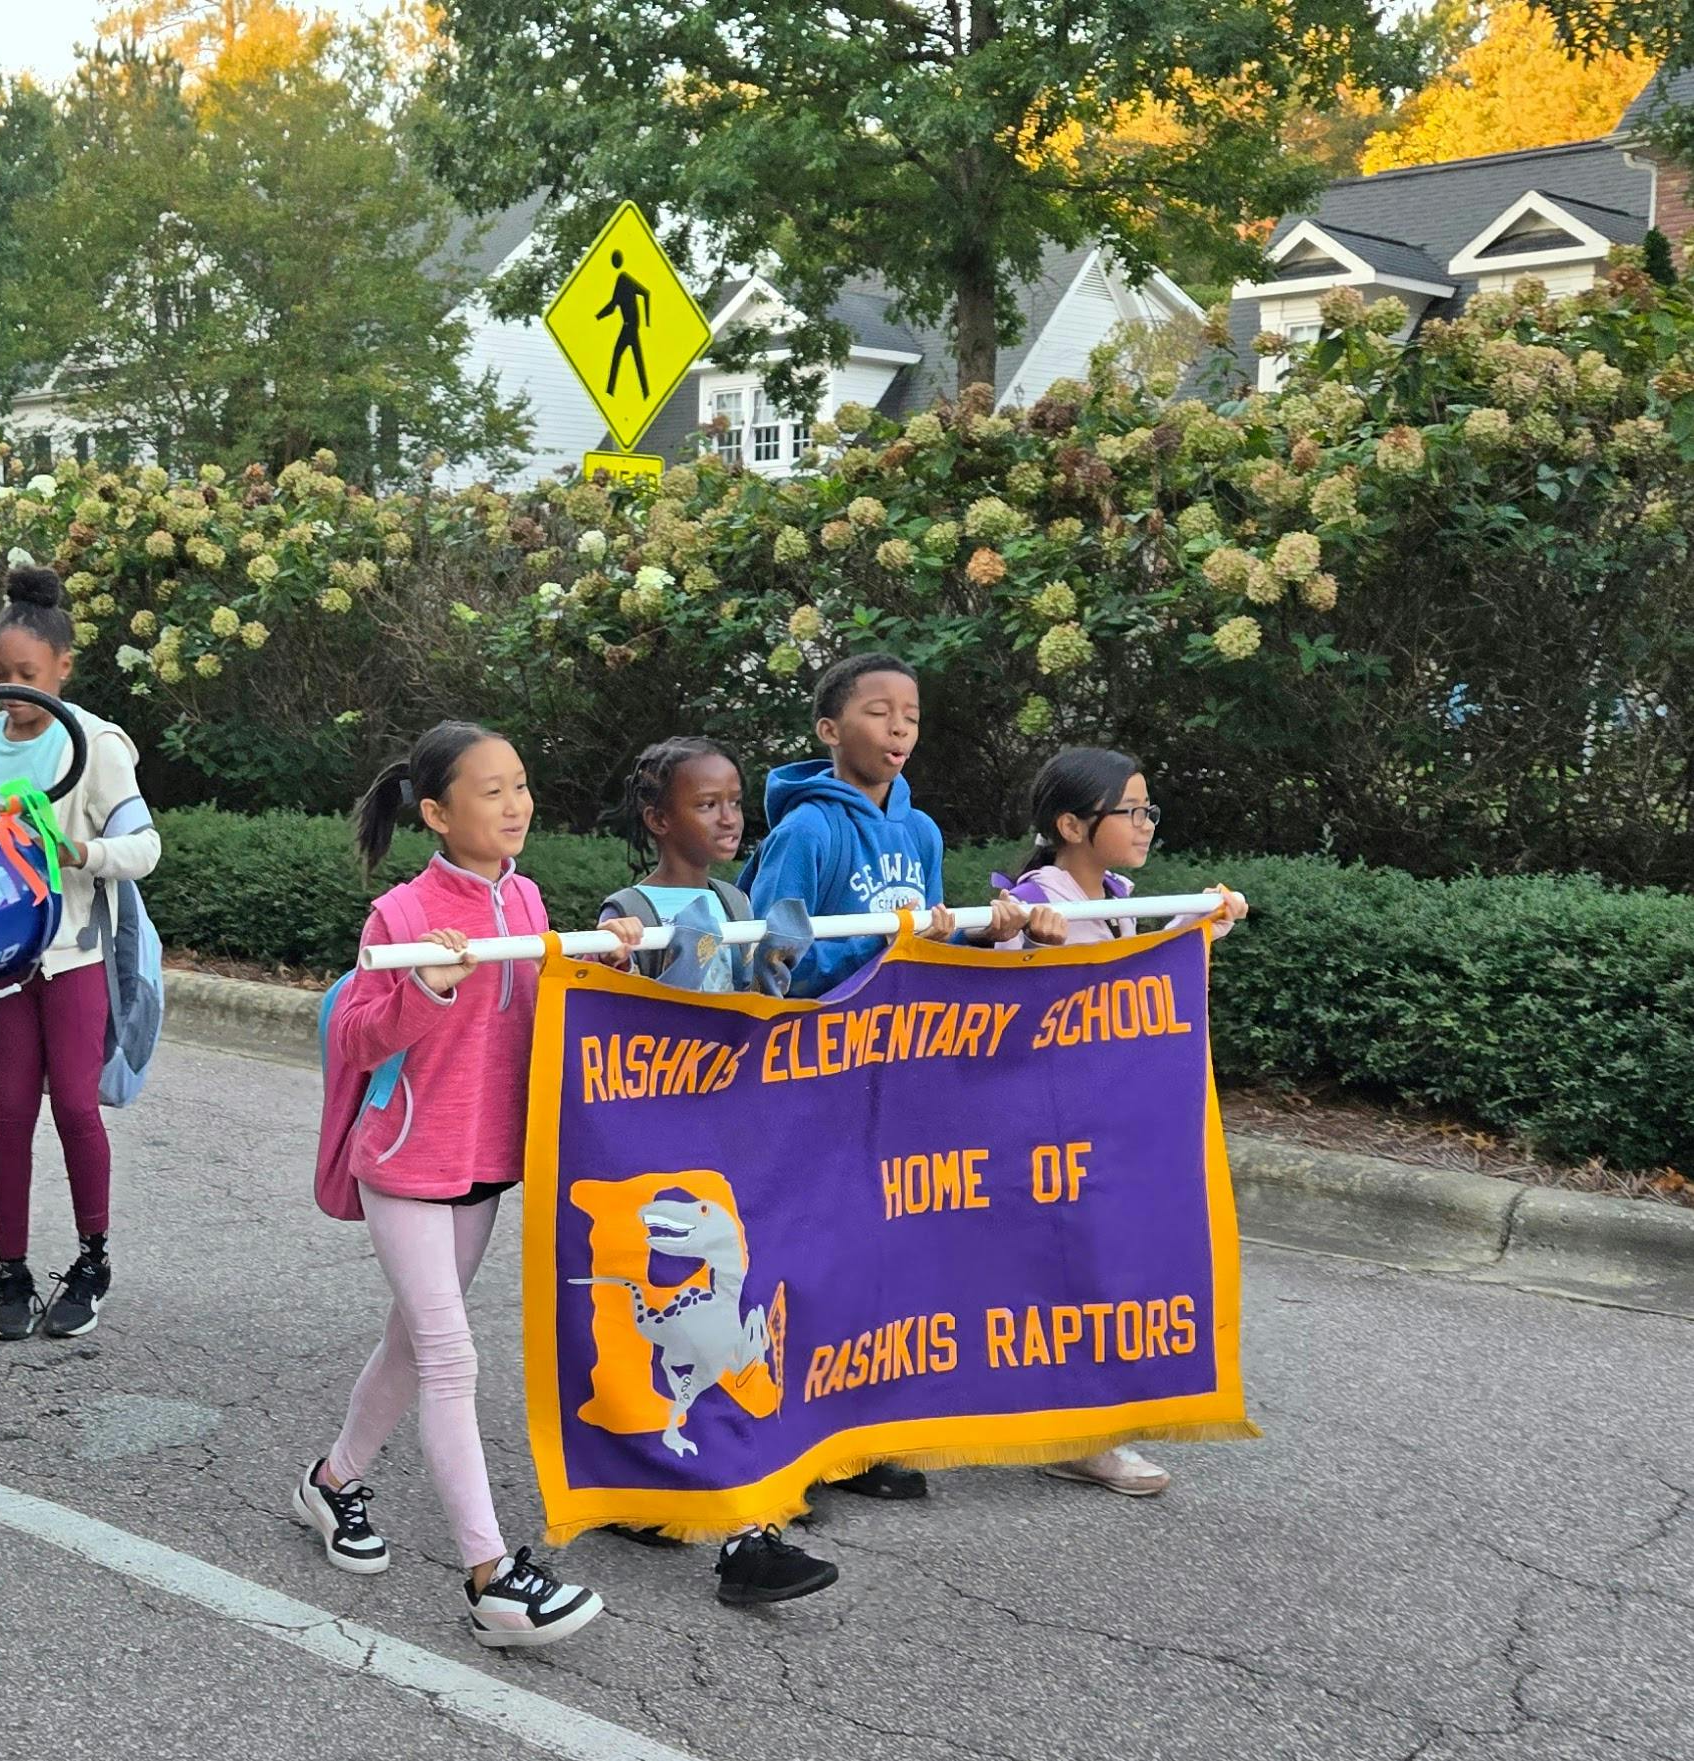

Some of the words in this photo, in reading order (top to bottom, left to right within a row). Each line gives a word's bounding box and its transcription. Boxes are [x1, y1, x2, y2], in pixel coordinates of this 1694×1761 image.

[580, 1034, 750, 1103] RASHKIS
[761, 1003, 1017, 1084] ELEMENTARY
[1032, 975, 1192, 1050] SCHOOL
[881, 1149, 990, 1221] HOME
[1031, 1141, 1092, 1204] OF
[804, 1312, 958, 1403] RASHKIS
[986, 1295, 1196, 1368] RAPTORS
